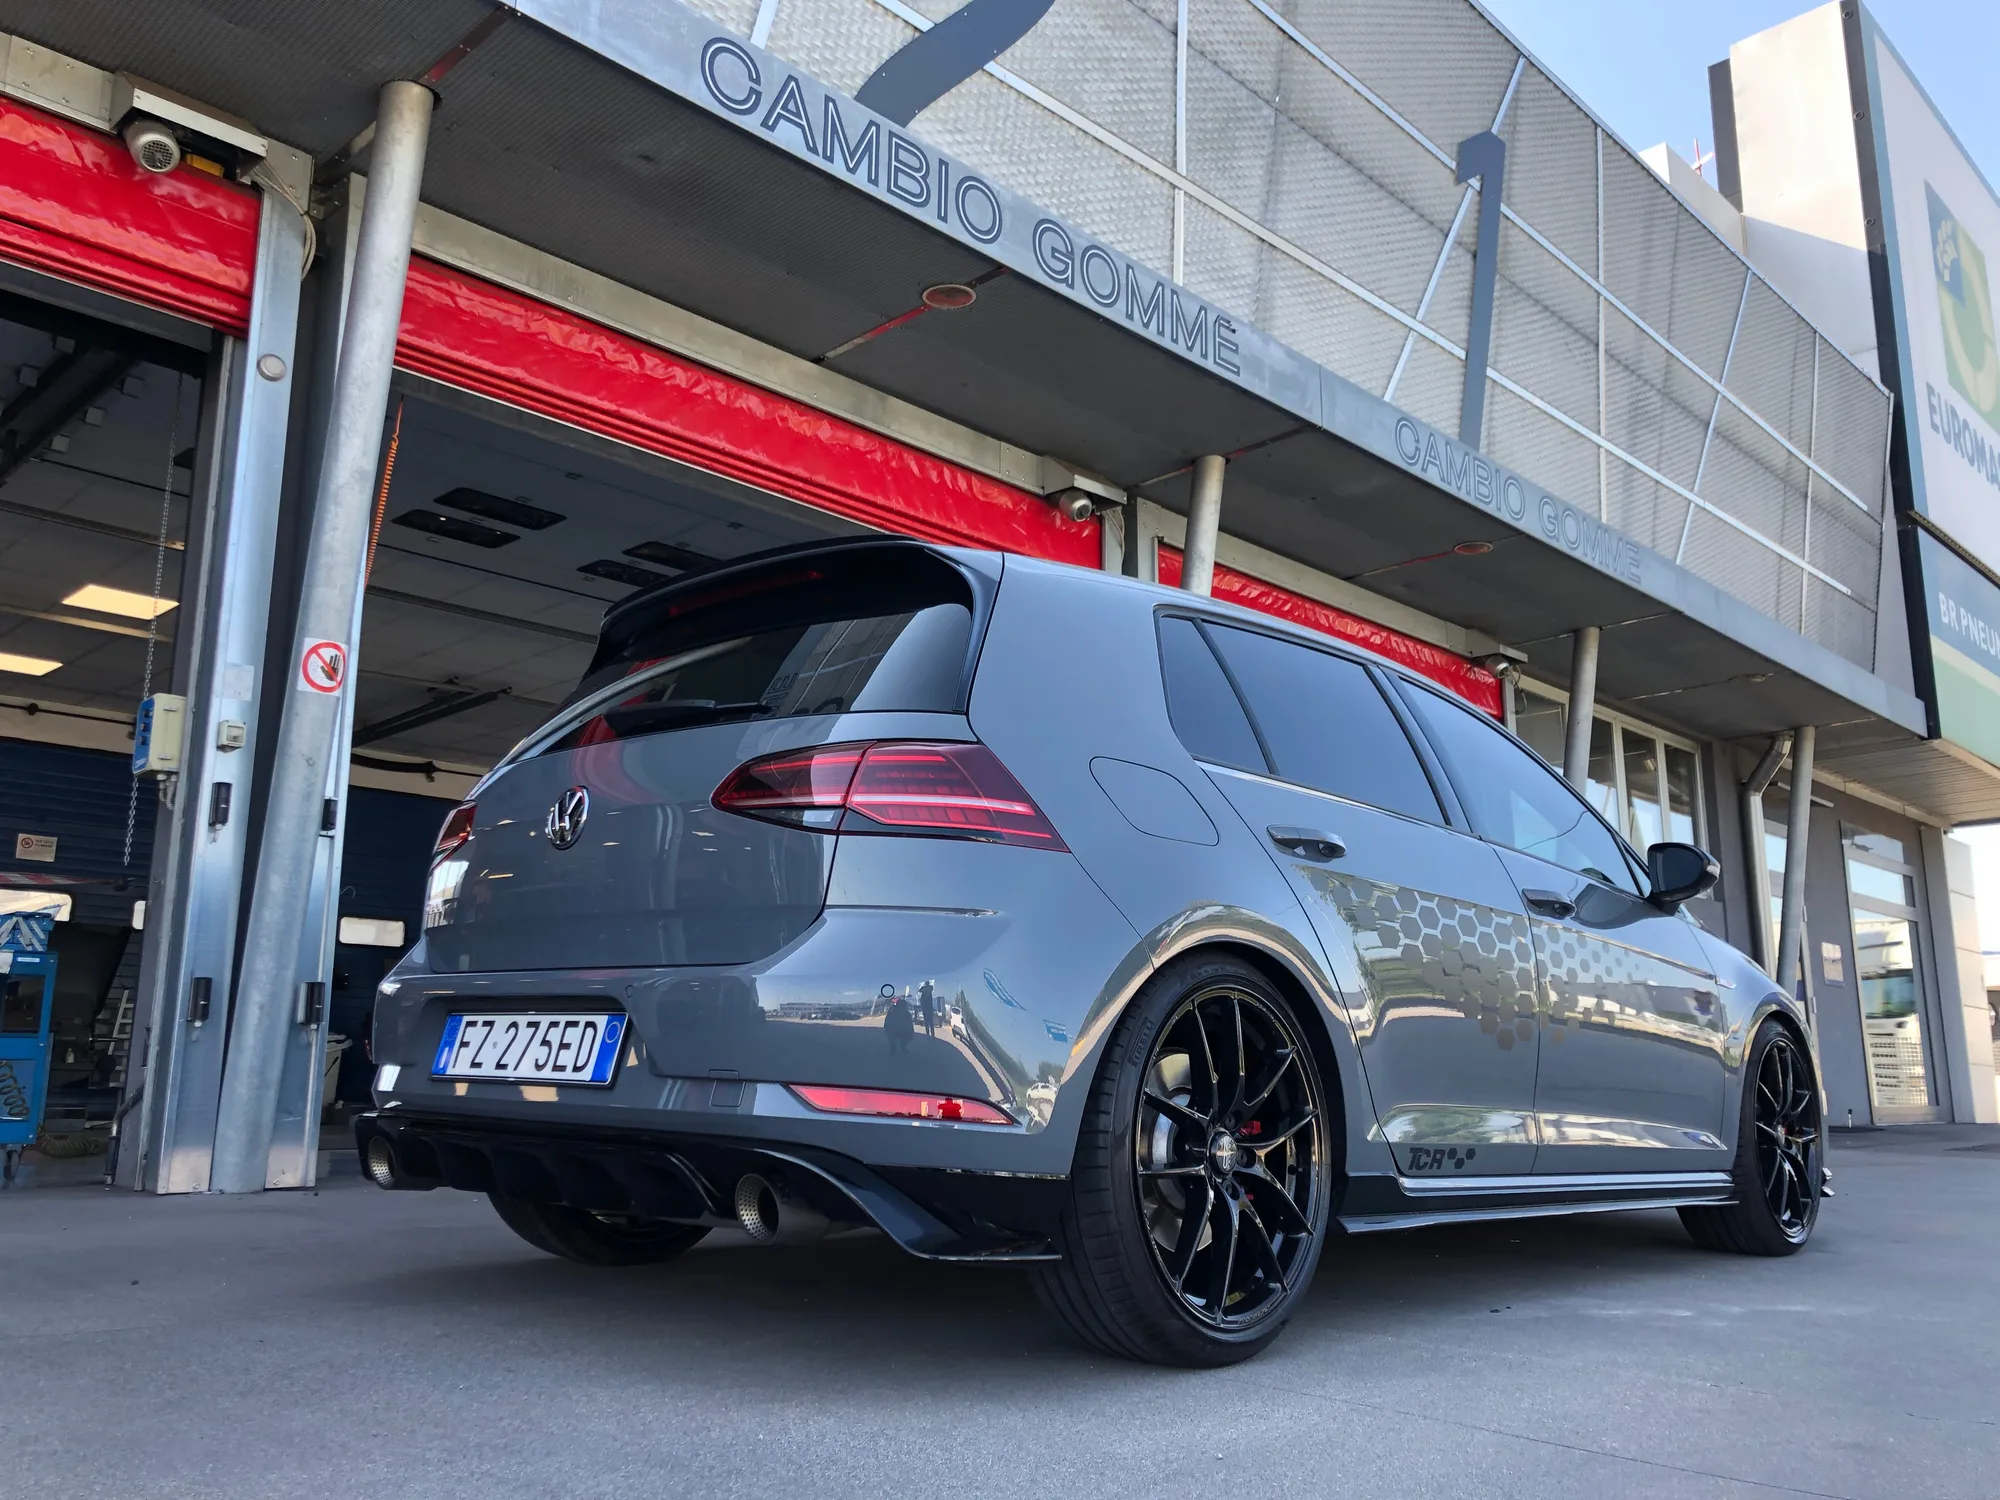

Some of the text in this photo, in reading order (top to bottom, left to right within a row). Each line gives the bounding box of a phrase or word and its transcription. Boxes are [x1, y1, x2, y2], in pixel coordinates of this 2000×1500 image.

[700, 36, 1003, 244] CAMBIO
[1032, 217, 1242, 377] GOMME
[1926, 381, 2000, 492] EUROMA
[1394, 416, 1642, 584] CAMBIO GOMME
[1938, 591, 1959, 633] BR
[452, 1020, 599, 1073] FZ 275ED
[1127, 1016, 1155, 1068] PIRELLI
[1408, 1146, 1446, 1171] TCR
